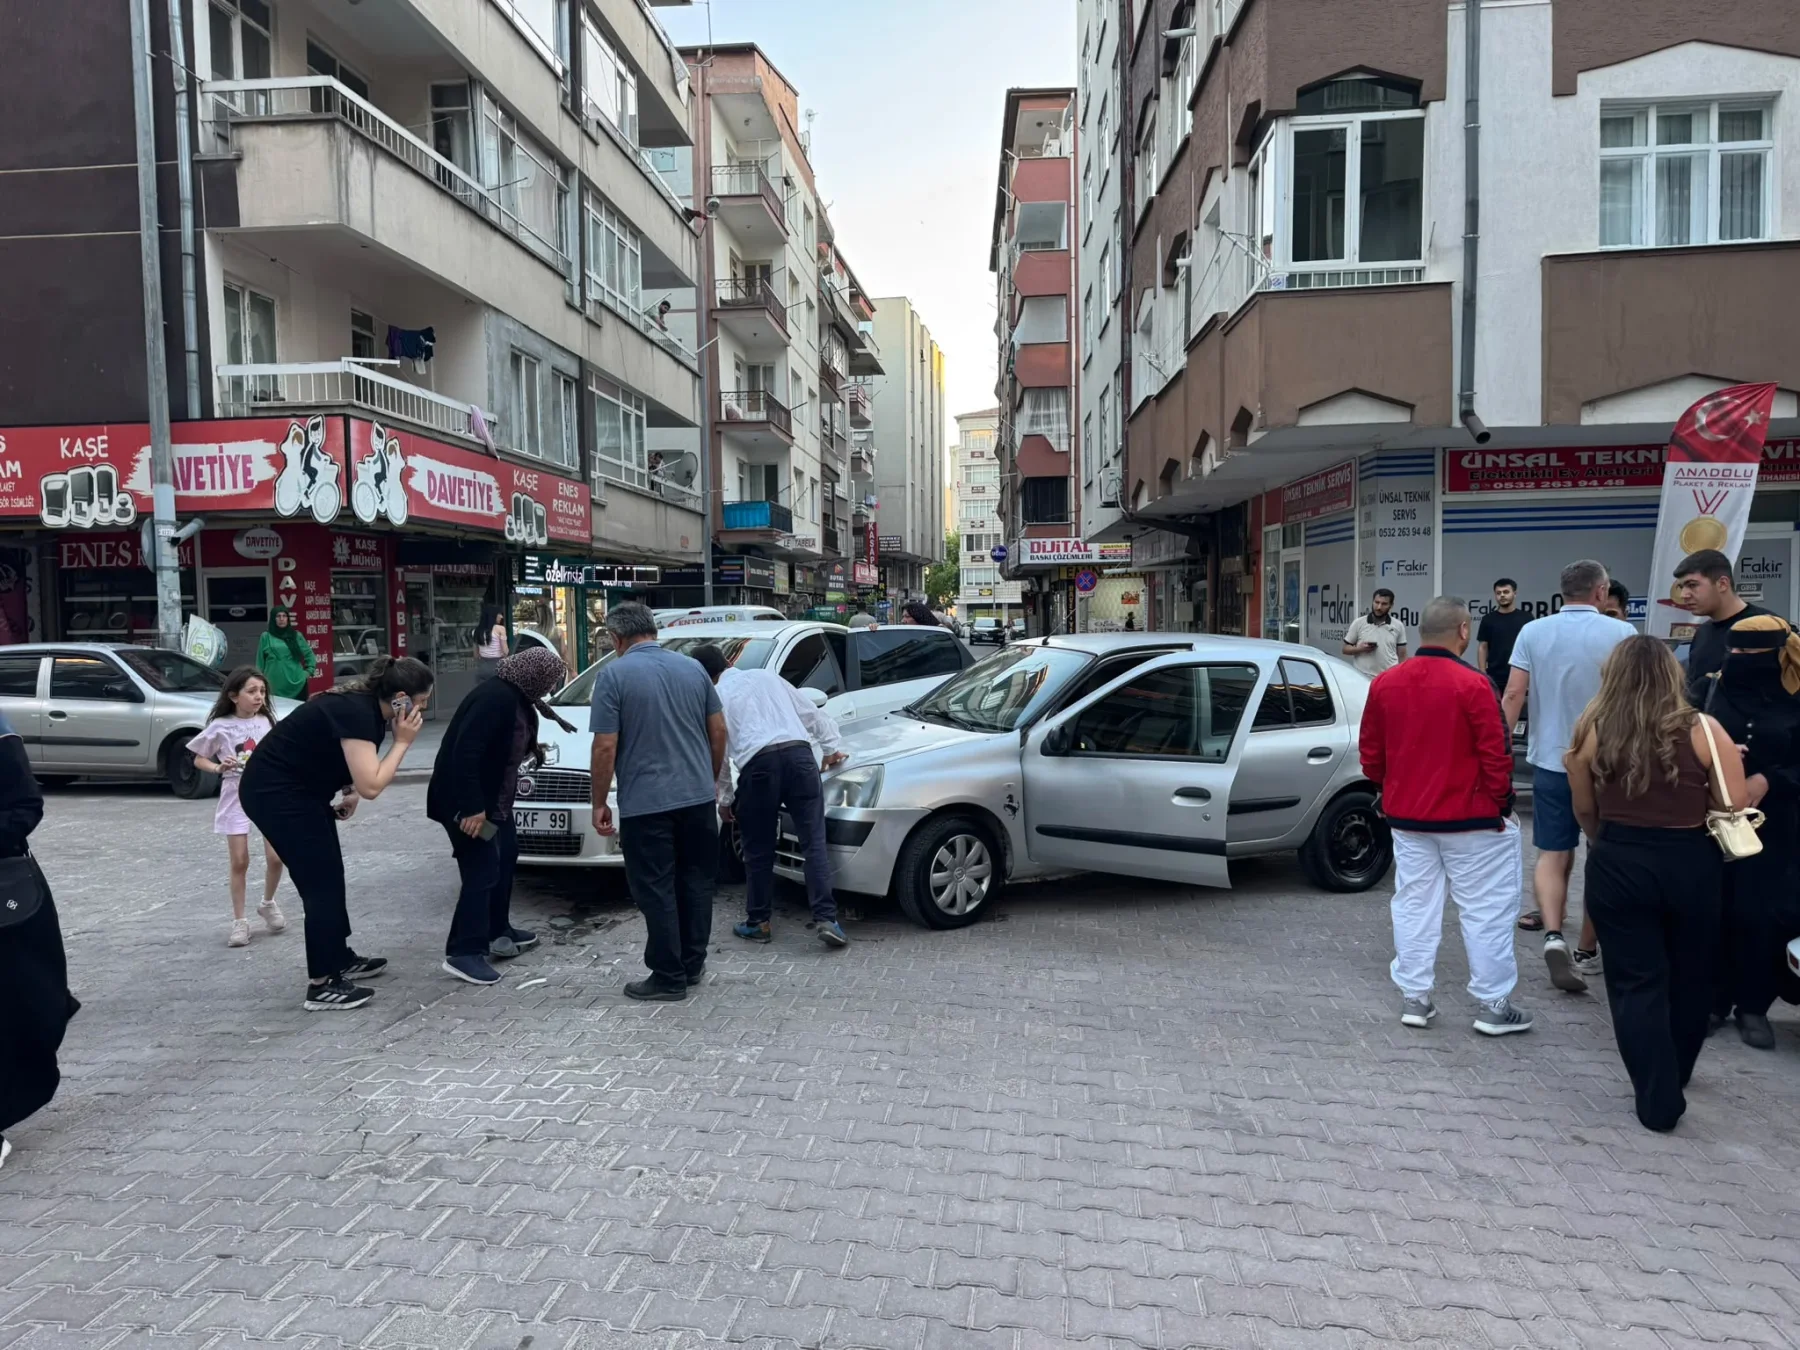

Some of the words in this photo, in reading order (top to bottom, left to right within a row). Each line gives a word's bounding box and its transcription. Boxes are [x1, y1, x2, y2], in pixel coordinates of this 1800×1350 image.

[60, 435, 109, 462] KAŞE
[1461, 451, 1565, 469] ÜNSAL
[513, 469, 538, 492] KAŞE
[1327, 464, 1351, 489] SERVİS
[1469, 467, 1553, 481] Elektrikli
[1558, 468, 1580, 478] Ev
[1585, 465, 1653, 478] Aletleri
[1675, 467, 1754, 478] ANADOLU
[427, 470, 494, 512] DAVETİYE
[558, 482, 579, 499] ENES
[1493, 481, 1536, 490] 0532
[1540, 480, 1573, 489] 263
[1577, 479, 1598, 488] 94
[1603, 478, 1625, 487] 48
[1673, 480, 1704, 488] PLAKET
[1707, 480, 1714, 488] &
[1717, 480, 1751, 489] REKLAM
[1379, 489, 1403, 504] ÜNSAL
[1403, 487, 1431, 503] TEKNİK
[552, 498, 585, 518] REKLAM
[1392, 508, 1417, 521] SERVİS
[1379, 527, 1396, 538] 0532
[1397, 527, 1411, 537] 263
[1412, 527, 1421, 537] 94
[1422, 526, 1431, 537] 48
[246, 534, 280, 548] DAVETİYE
[355, 538, 377, 552] KAŞE
[868, 522, 876, 565] KASAP
[60, 540, 132, 569] ENES
[352, 552, 382, 567] MÜHÜR
[1030, 553, 1051, 561] BASKI
[1397, 559, 1428, 572] Fakir
[1741, 556, 1783, 573] Fakir
[1321, 583, 1354, 625] Fakir
[1469, 599, 1498, 615] Fak
[549, 812, 566, 829] 99
